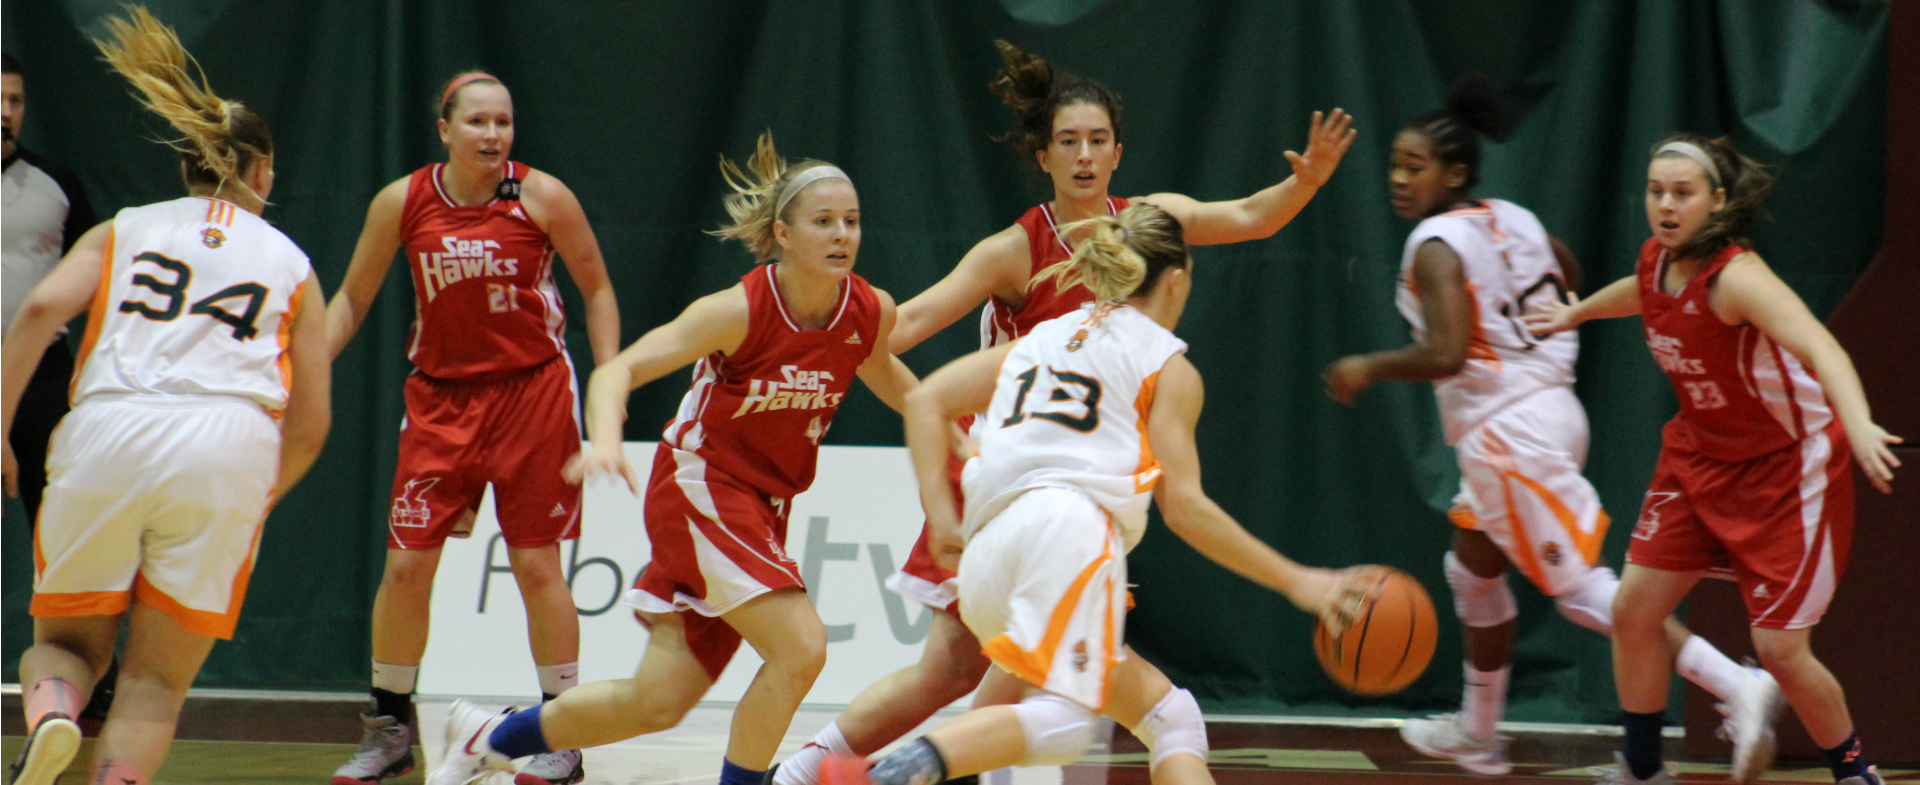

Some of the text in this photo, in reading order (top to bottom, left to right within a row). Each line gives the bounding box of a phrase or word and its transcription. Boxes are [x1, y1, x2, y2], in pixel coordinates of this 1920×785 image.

[118, 251, 270, 343] 34
[419, 251, 518, 303] Hawks
[486, 283, 520, 313] 21
[731, 379, 843, 419] Hawks
[998, 365, 1102, 434] 13
[1683, 381, 1727, 409] 23
